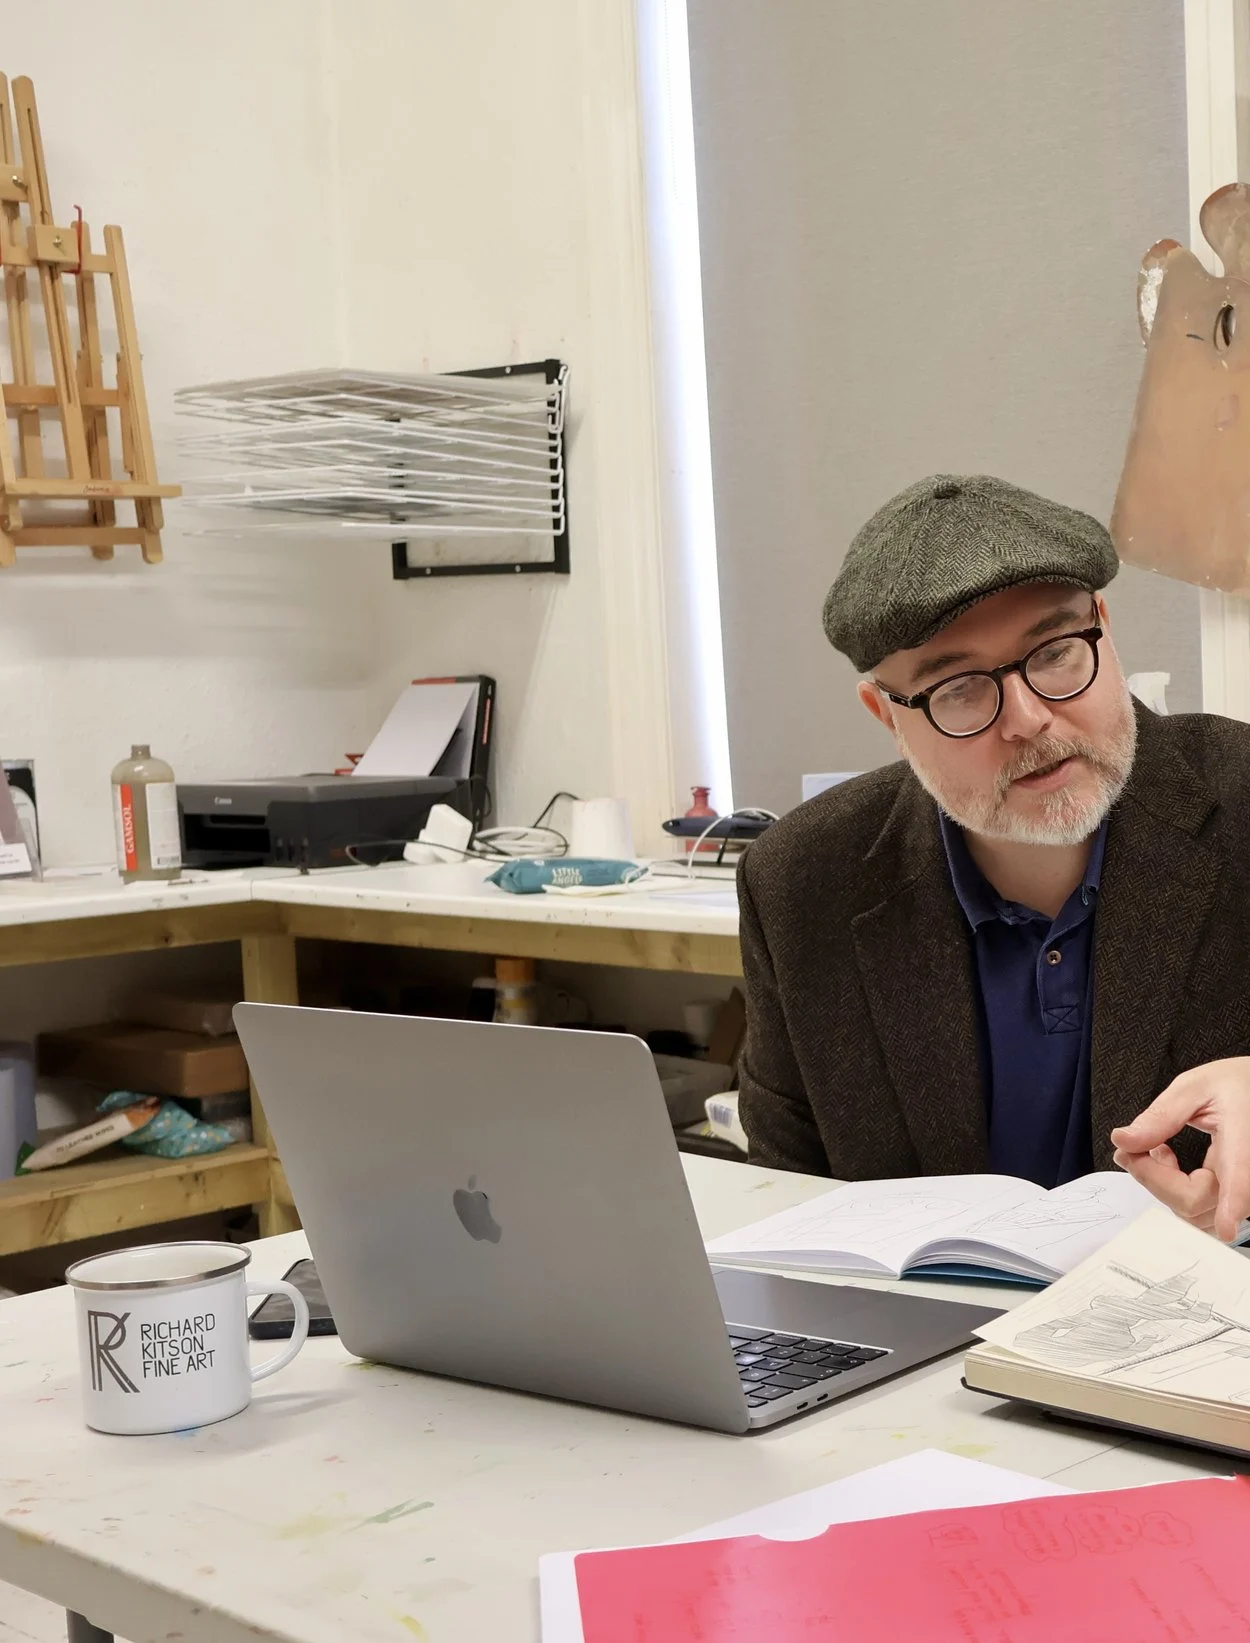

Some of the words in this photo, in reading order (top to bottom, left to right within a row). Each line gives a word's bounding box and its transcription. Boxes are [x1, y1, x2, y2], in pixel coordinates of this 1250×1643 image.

[122, 804, 135, 854] GAMSOL
[140, 1313, 216, 1342] RICHARD
[141, 1335, 204, 1360] KITSON
[142, 1356, 182, 1379] FINE
[186, 1350, 216, 1373] ART
